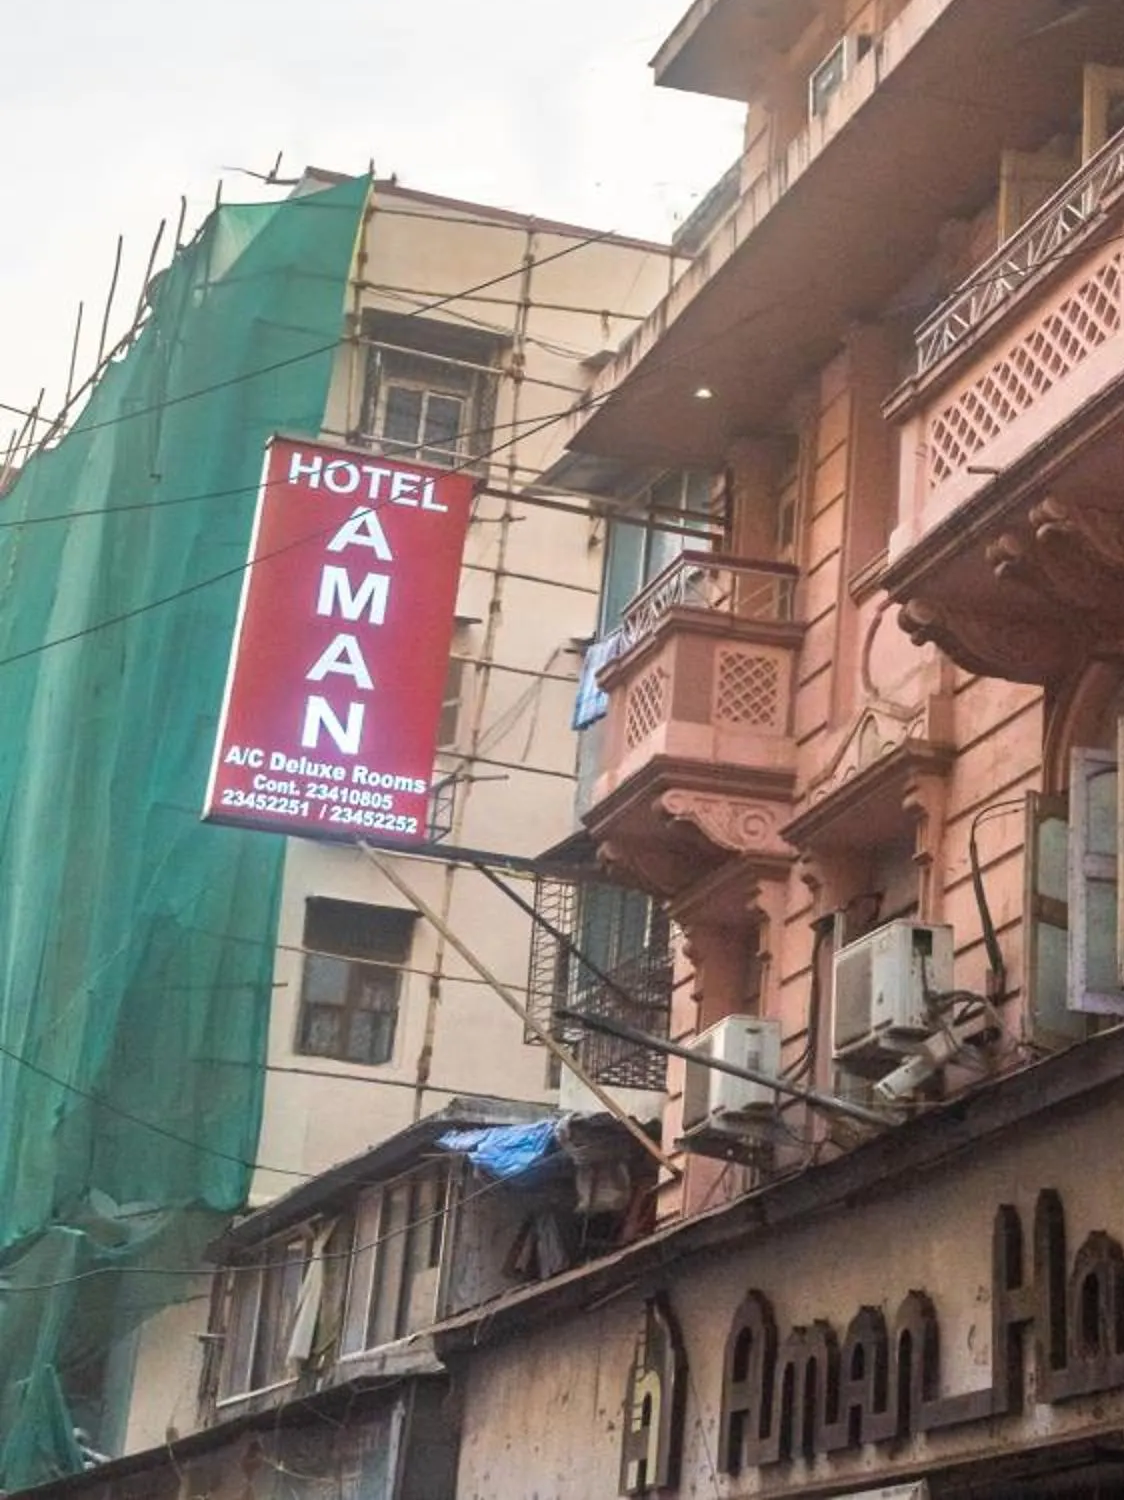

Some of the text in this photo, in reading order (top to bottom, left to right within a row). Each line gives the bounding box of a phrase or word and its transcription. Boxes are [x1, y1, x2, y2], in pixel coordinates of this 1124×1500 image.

[289, 452, 449, 513] HOTEL
[301, 506, 393, 755] AMAN
[224, 745, 427, 794] A/C Deluxe Rooms
[254, 774, 393, 810] Cont. 23410805
[222, 789, 309, 817] 23452251
[330, 806, 418, 834] 23452252
[718, 1288, 985, 1476] Aman
